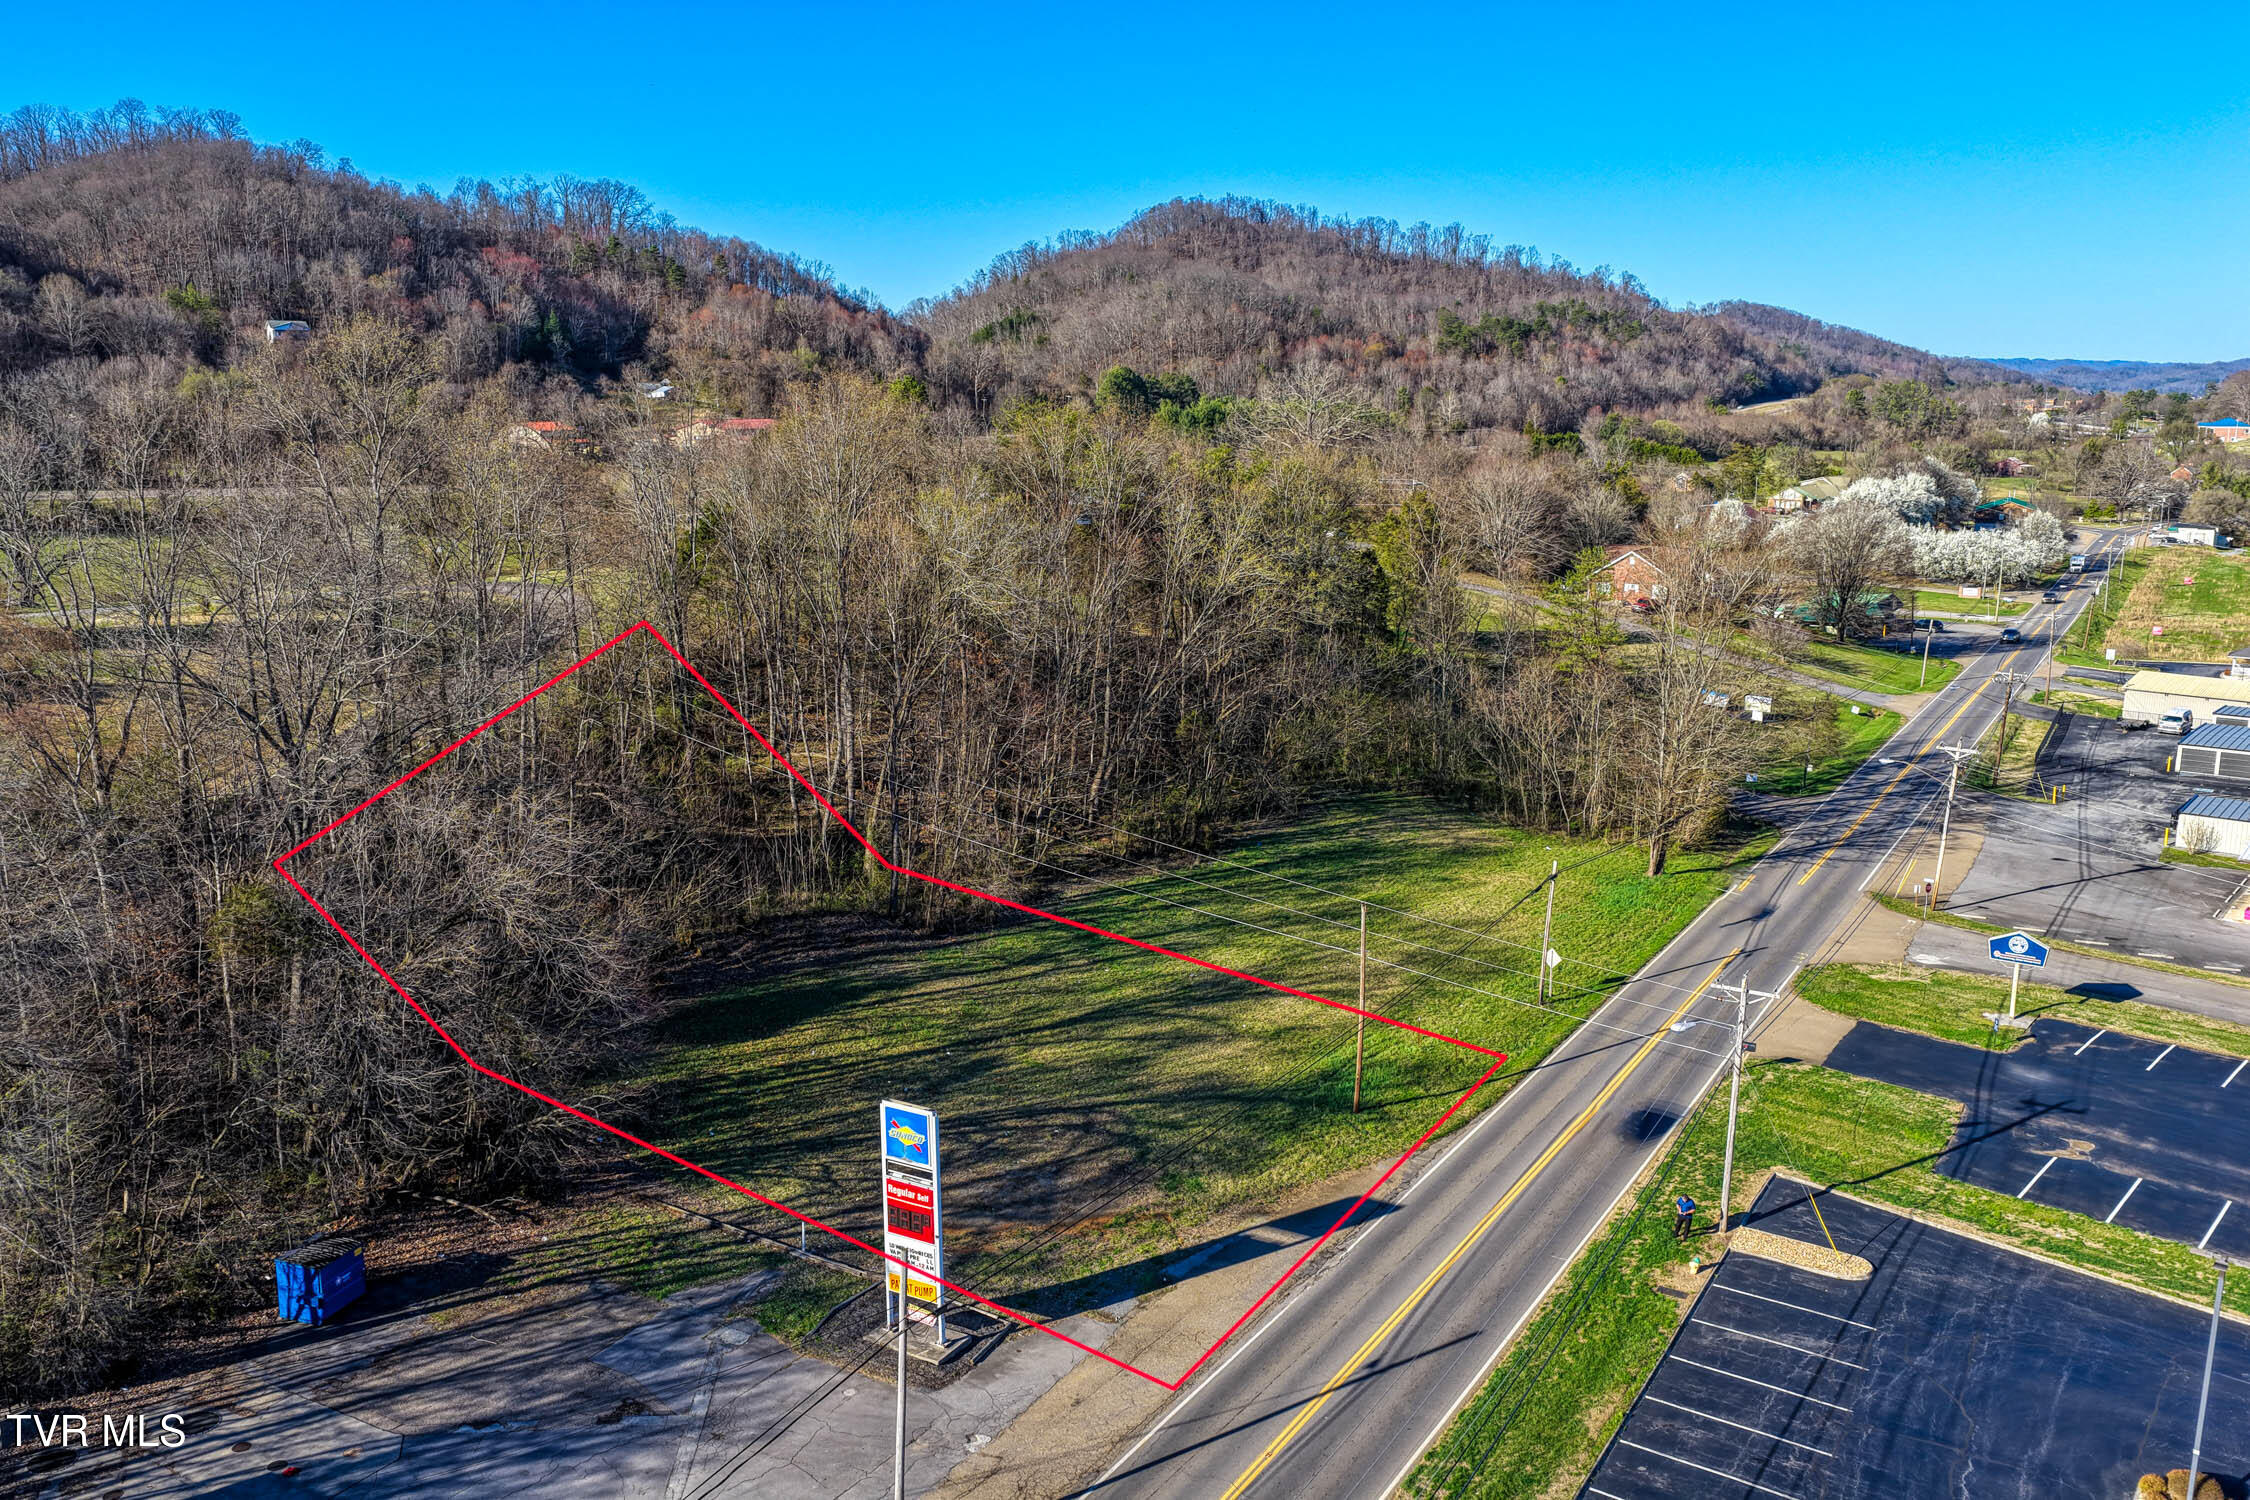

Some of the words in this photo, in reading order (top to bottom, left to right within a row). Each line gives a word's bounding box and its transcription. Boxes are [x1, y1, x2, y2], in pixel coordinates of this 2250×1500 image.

[891, 1130, 923, 1143] SUNOCO
[888, 1184, 915, 1199] Regular
[917, 1193, 929, 1203] Self
[914, 1286, 933, 1297] PUMP
